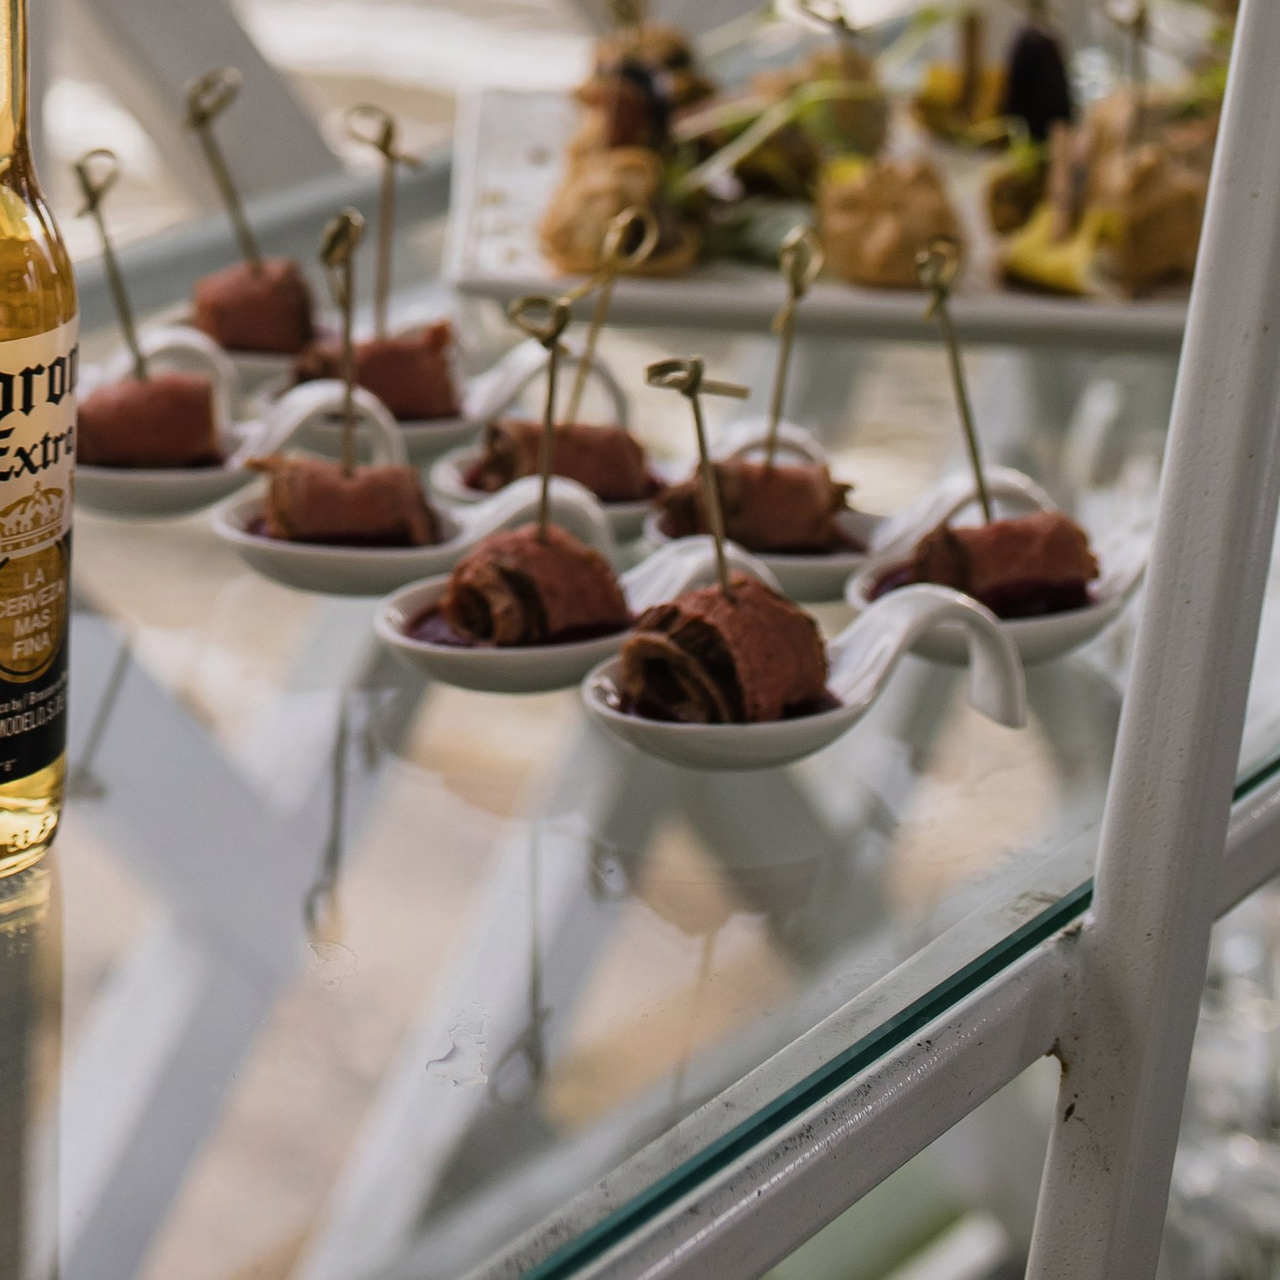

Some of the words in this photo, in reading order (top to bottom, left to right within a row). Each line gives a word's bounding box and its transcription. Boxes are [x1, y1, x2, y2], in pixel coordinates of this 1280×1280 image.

[23, 567, 46, 590] LA
[14, 608, 51, 638] MAS
[12, 631, 52, 660] FINA
